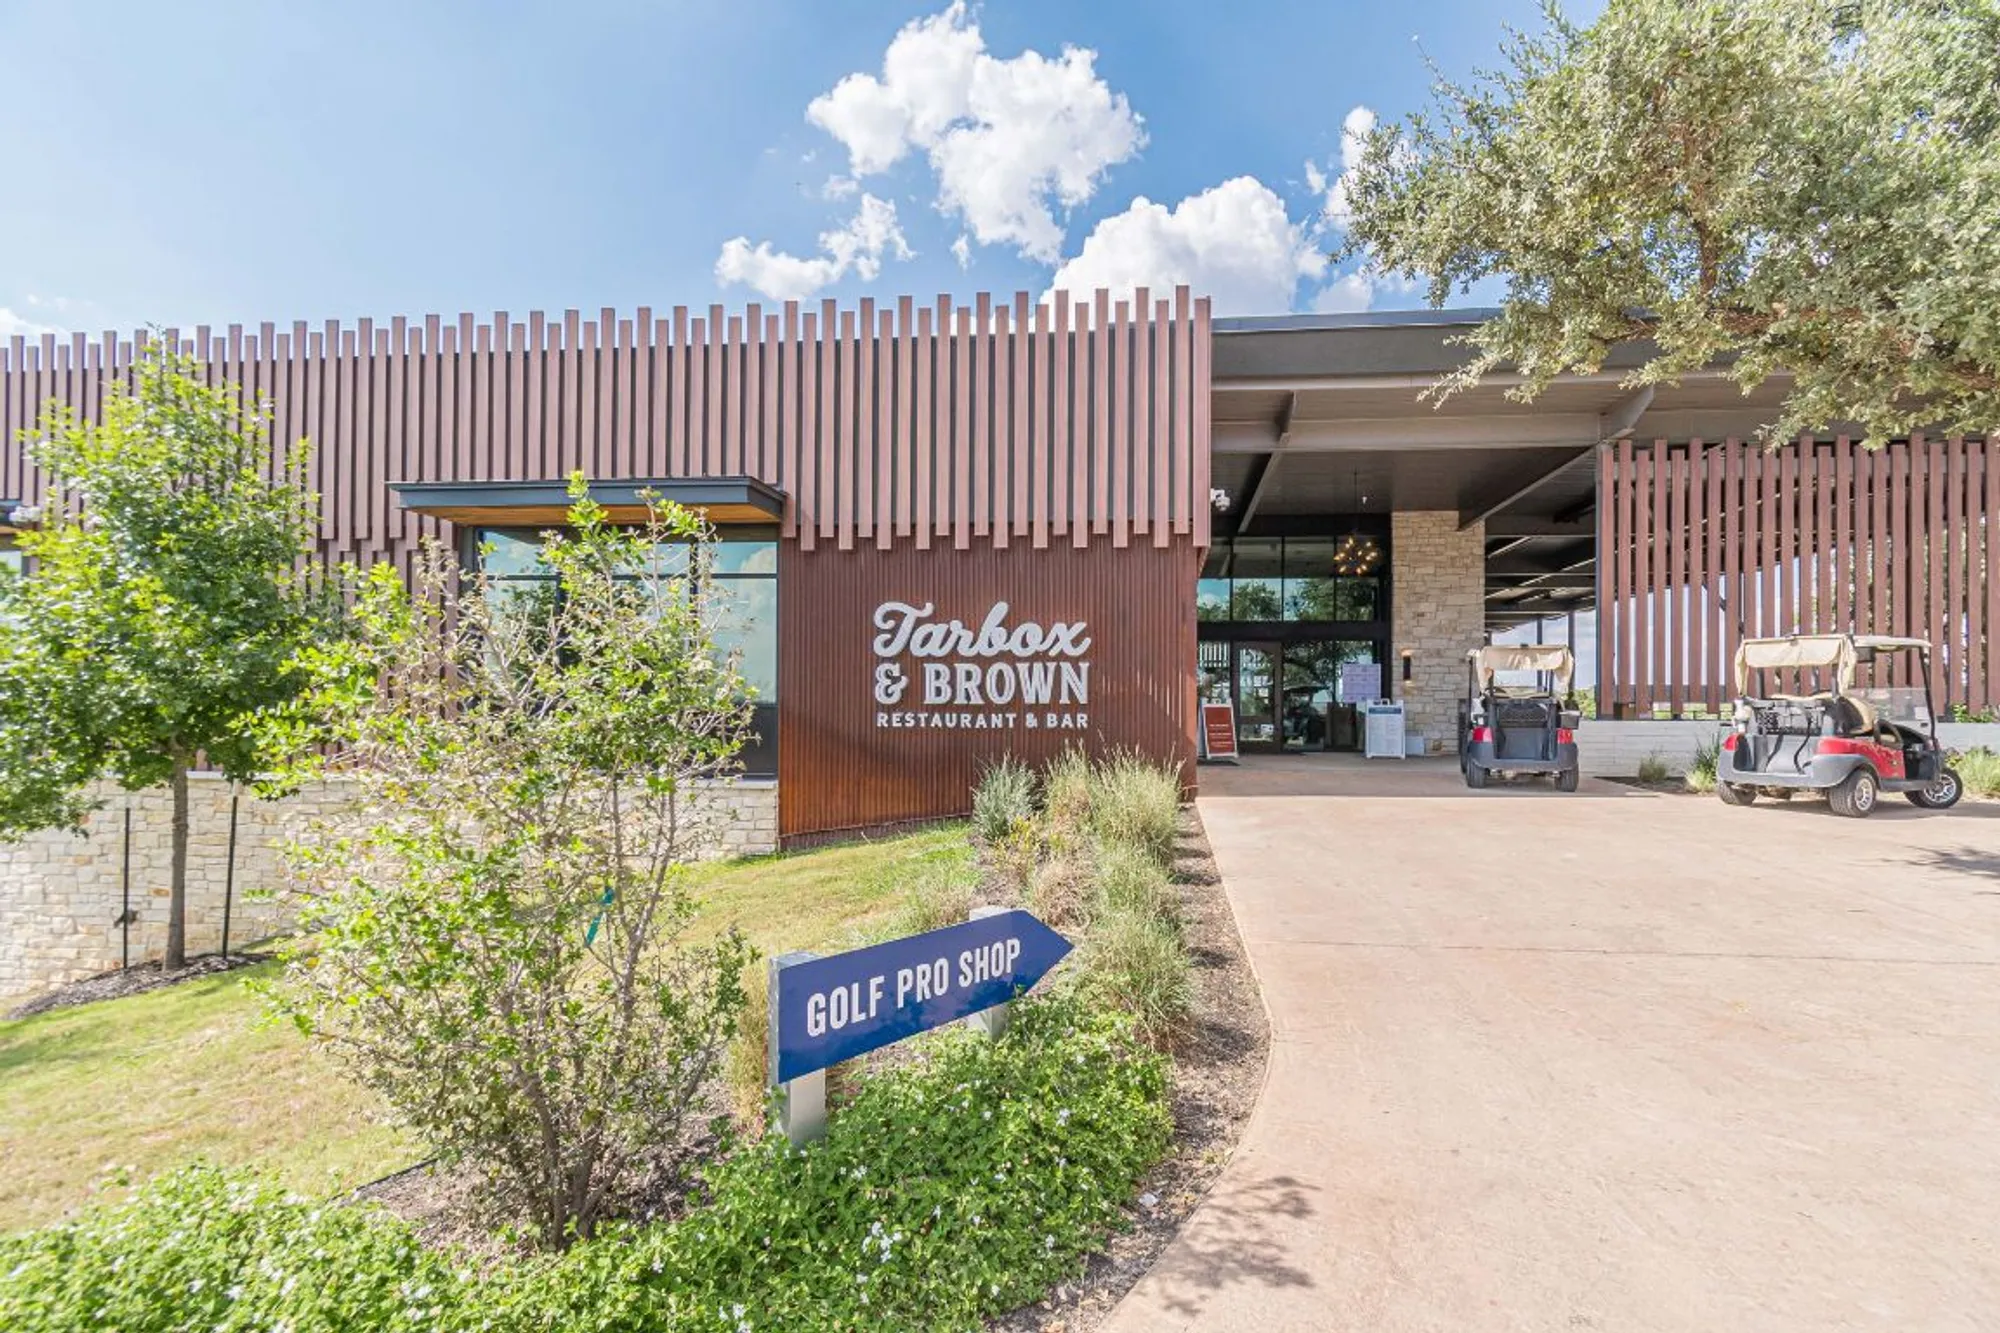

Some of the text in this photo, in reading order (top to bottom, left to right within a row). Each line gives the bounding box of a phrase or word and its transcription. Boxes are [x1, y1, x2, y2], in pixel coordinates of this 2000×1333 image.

[873, 601, 1092, 657] Tarbox
[875, 662, 1090, 704] & BROWN
[876, 712, 1088, 728] RESTAURANT & BAR
[807, 938, 1021, 1037] GOLF PRO SHOP
